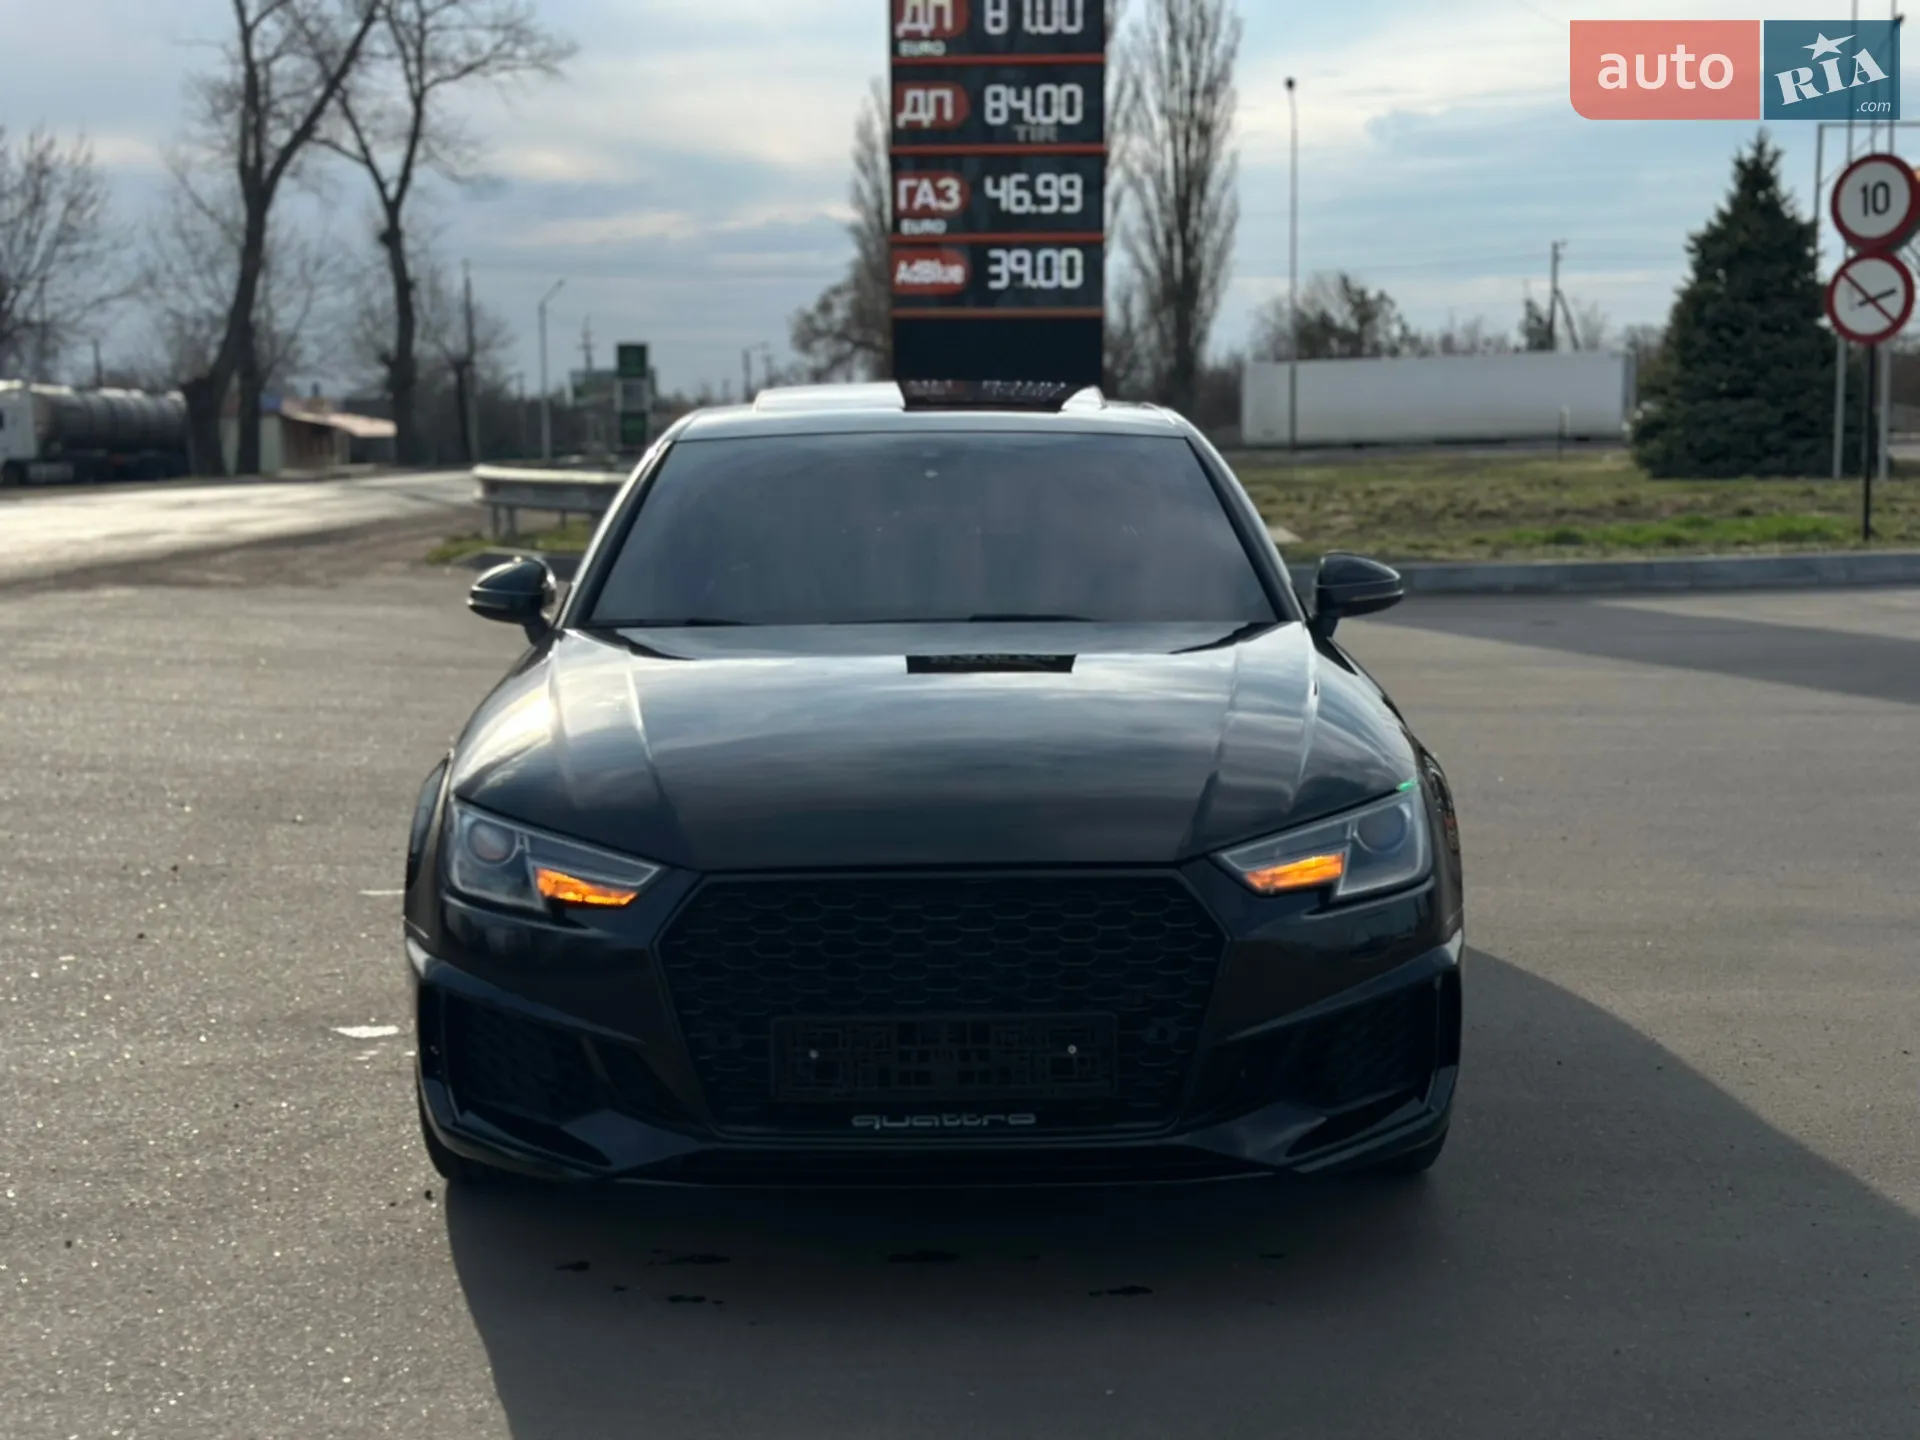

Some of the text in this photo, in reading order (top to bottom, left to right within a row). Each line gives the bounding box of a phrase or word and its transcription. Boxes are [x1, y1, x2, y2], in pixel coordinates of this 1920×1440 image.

[896, 83, 1084, 129] ДП 84.00
[897, 173, 1084, 215] ГАЗ 46.99
[1860, 180, 1891, 218] 10
[987, 247, 1084, 290] 39.00
[851, 1112, 1037, 1130] quattro
